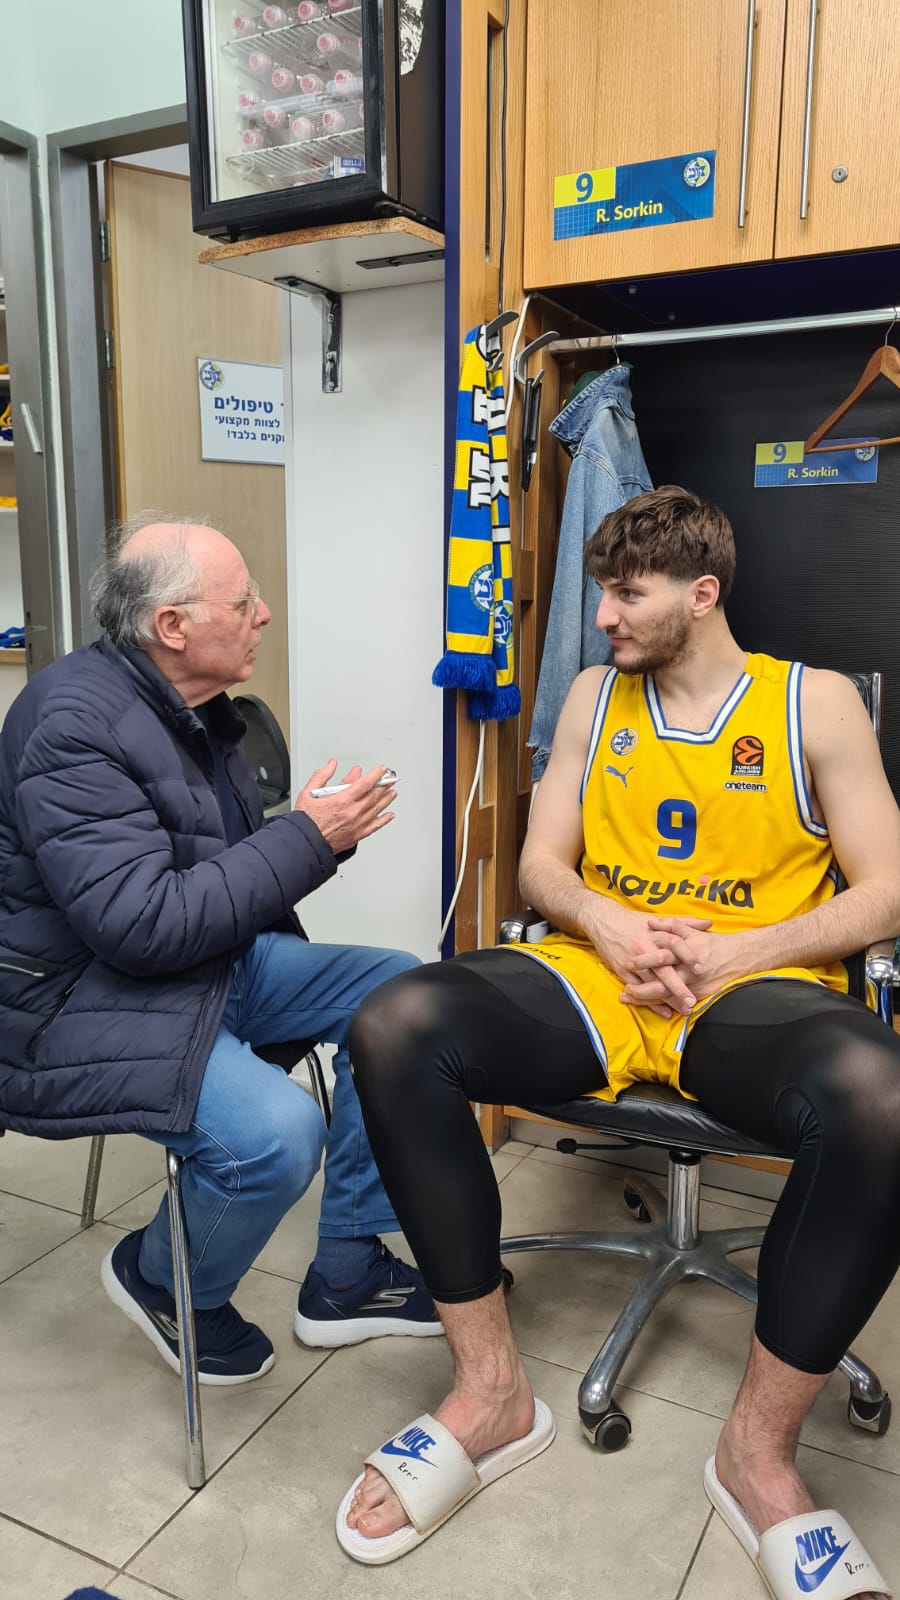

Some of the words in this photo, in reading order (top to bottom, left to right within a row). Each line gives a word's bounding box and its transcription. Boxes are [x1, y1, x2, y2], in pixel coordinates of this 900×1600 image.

[575, 172, 594, 203] 9
[596, 208, 610, 223] R.
[614, 200, 663, 221] Sorkin
[214, 395, 273, 413] טיפולים
[215, 415, 250, 427] מקצועי
[254, 418, 280, 428] לצוות
[227, 430, 257, 441] בלבד!
[773, 442, 787, 463] 9
[787, 468, 799, 479] R.
[801, 466, 839, 478] Sorkin
[724, 782, 767, 791] oneteam
[656, 798, 697, 860] 9
[398, 1426, 437, 1456] NIKE
[795, 1526, 842, 1567] NIKE
